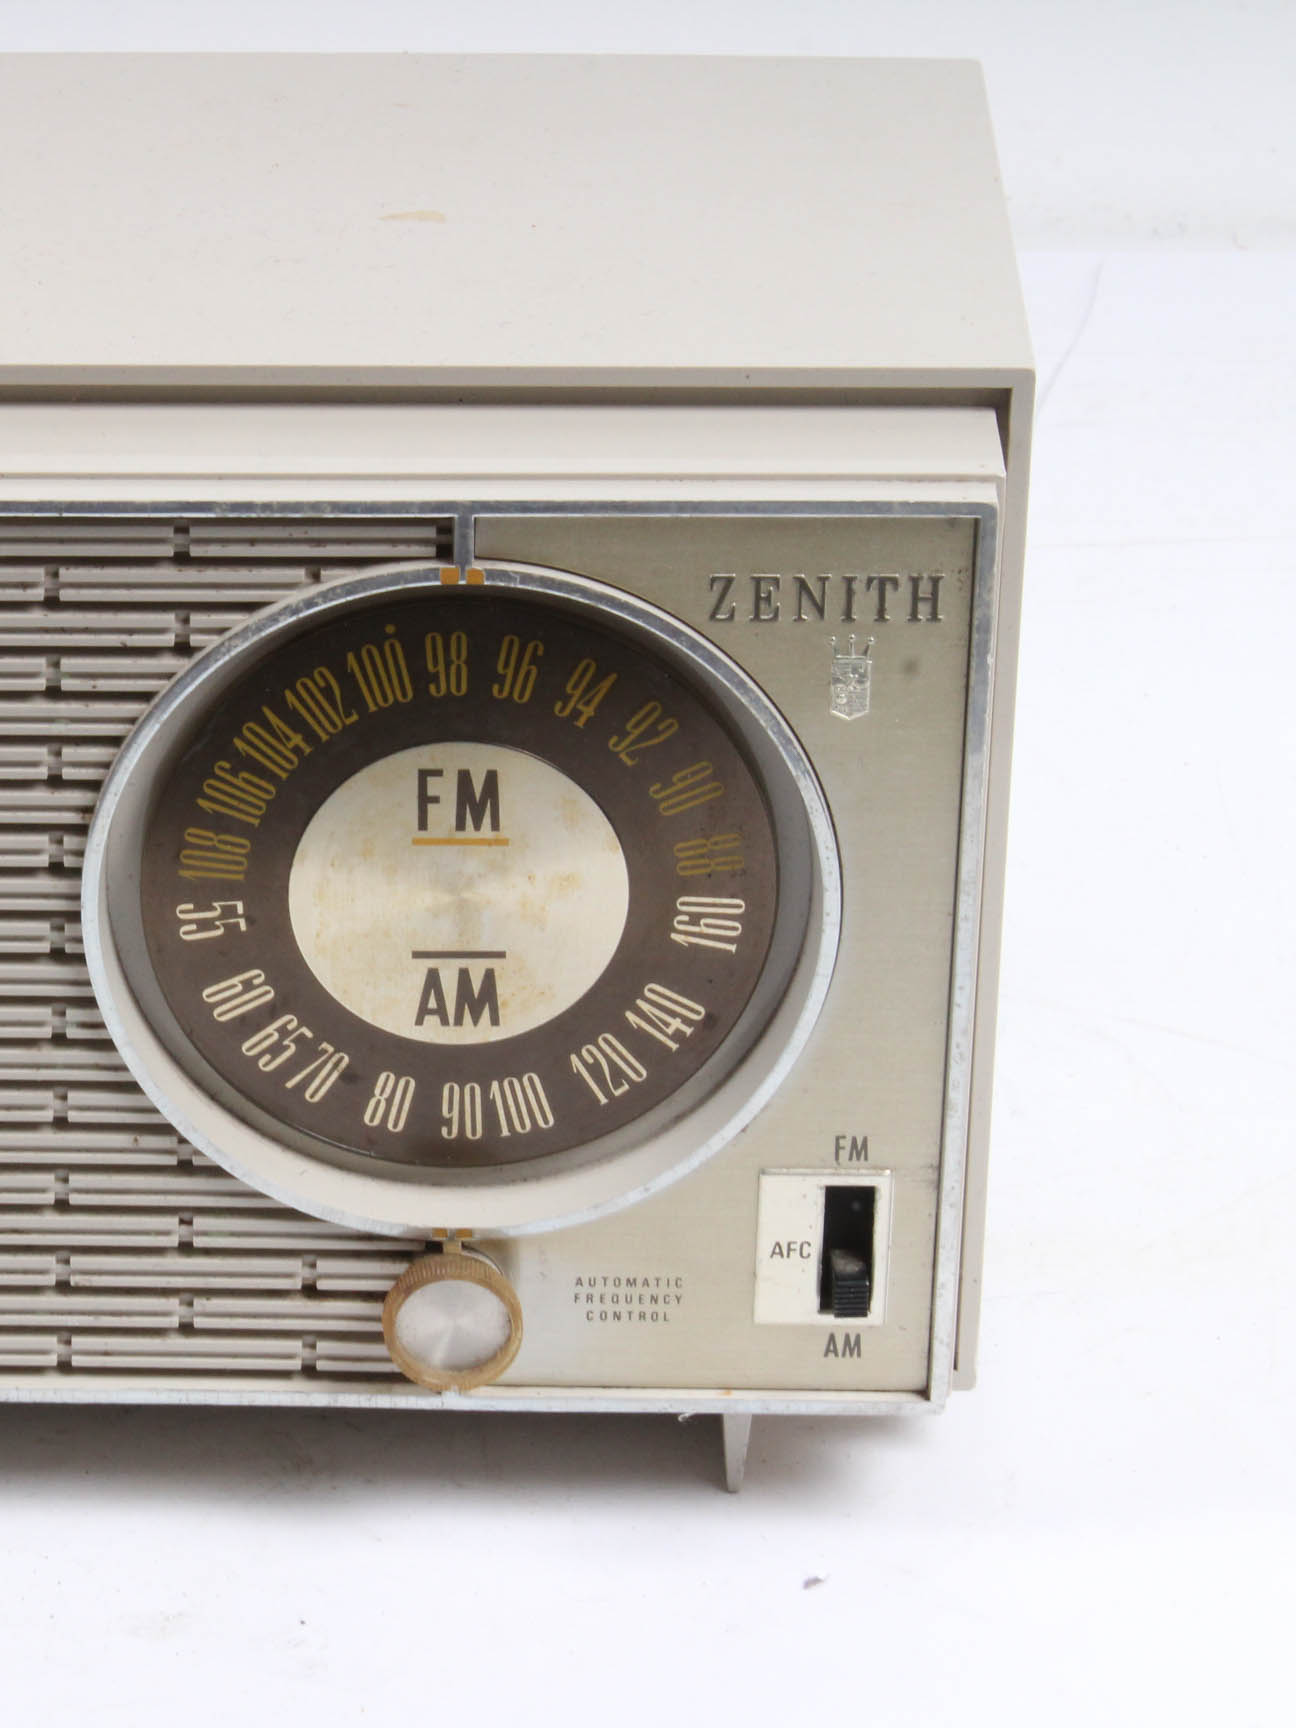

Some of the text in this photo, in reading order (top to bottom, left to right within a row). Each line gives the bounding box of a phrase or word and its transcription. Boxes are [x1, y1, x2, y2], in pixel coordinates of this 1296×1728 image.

[708, 573, 946, 622] ZENITH
[177, 632, 744, 880] 108 106 104 102 100 98 96 94 92 90 88
[417, 768, 501, 832] FM
[414, 967, 501, 1026] AM
[176, 896, 745, 1140] 55 60 65 70 80 90 100 120 140 160
[835, 1135, 868, 1162] FM
[769, 1240, 812, 1260] AFC
[574, 1276, 684, 1289] AUTOMATIC
[573, 1293, 684, 1306] FREQUENCY
[585, 1309, 671, 1323] CONTROL
[823, 1333, 861, 1358] AM
